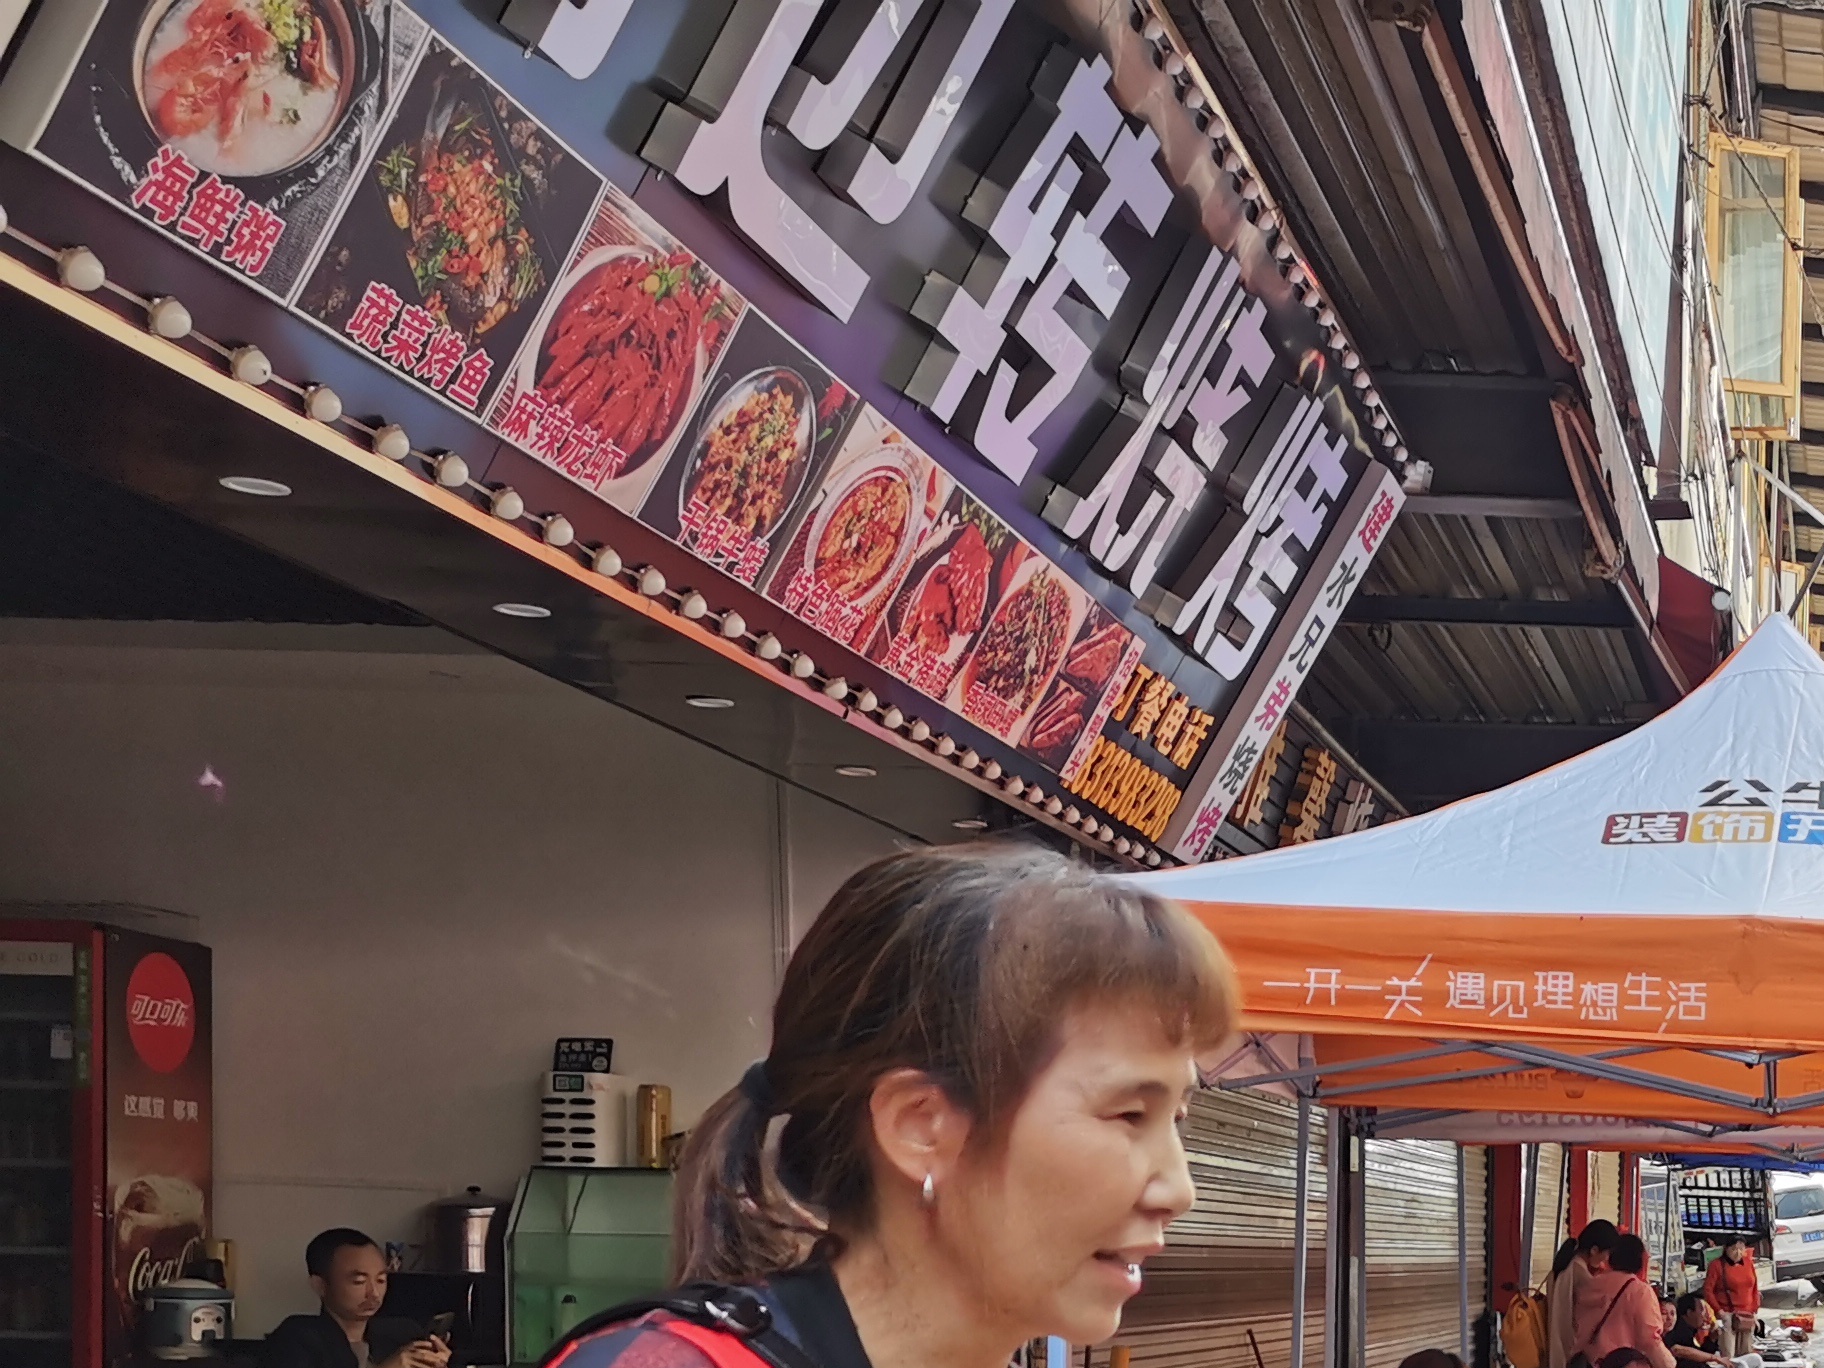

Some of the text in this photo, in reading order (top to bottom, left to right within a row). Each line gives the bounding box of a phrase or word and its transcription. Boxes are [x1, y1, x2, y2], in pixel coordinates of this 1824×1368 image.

[131, 145, 288, 276] 海鲜粥
[345, 281, 496, 411] 蔬菜烤鱼
[503, 388, 627, 491] 麻辣龙虾
[676, 497, 772, 588] 干锅牛蛙
[783, 567, 867, 644] 特色脑花
[1183, 490, 1396, 858] 建水兄弟烧烤
[1060, 735, 1182, 843] 8313983298
[130, 993, 192, 1027] 可口可乐
[1263, 953, 1708, 1034] 一开一关 遇见理想生活
